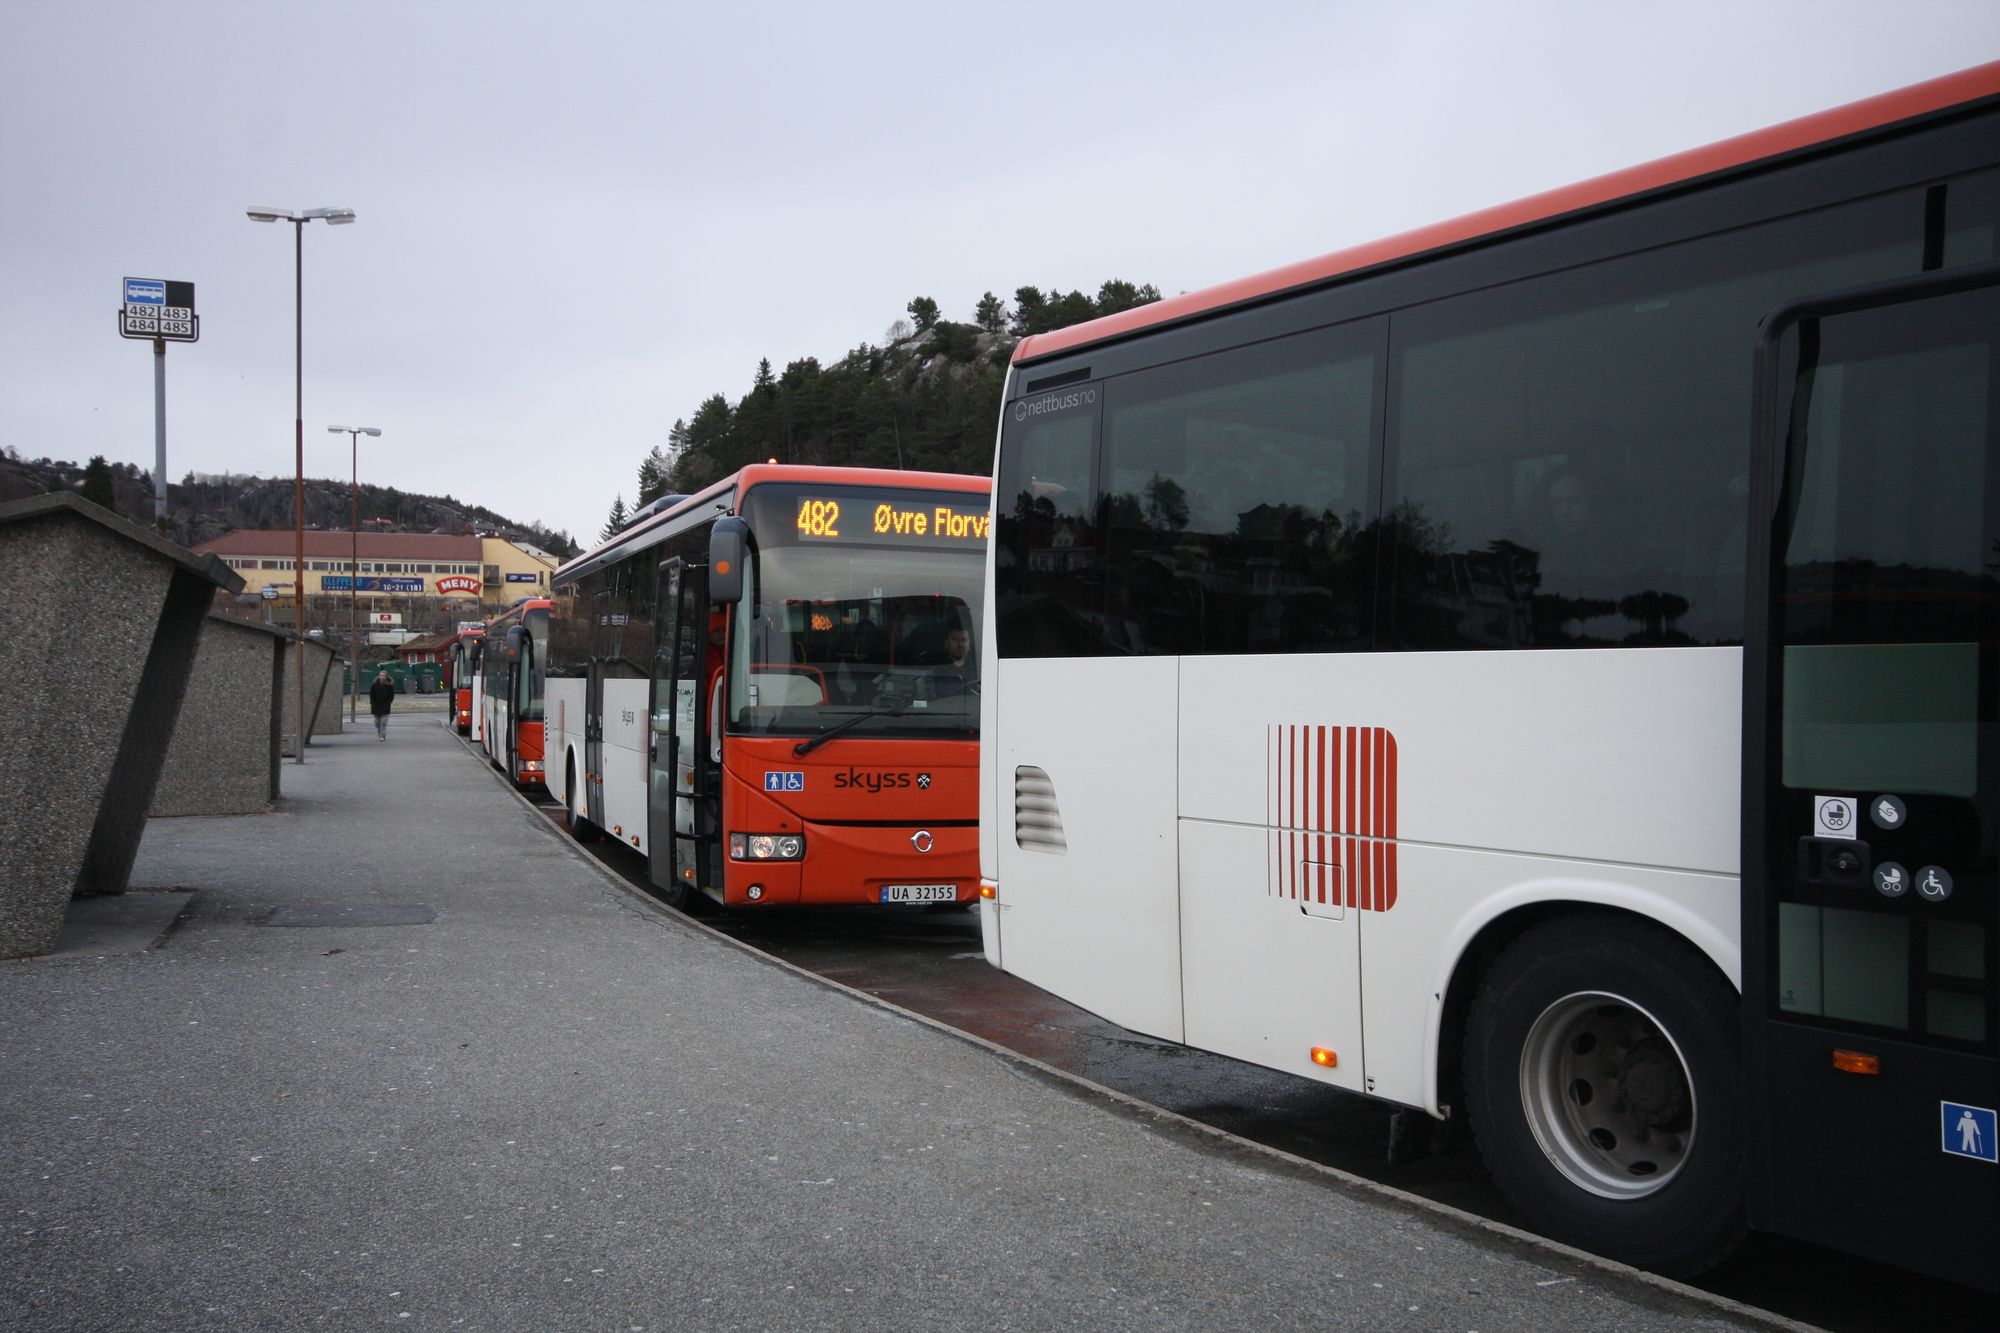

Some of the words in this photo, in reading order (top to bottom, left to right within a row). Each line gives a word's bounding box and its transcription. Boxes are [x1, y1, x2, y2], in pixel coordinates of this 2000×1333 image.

[129, 305, 155, 317] 482
[163, 308, 189, 319] 483
[129, 320, 155, 331] 484
[163, 322, 189, 333] 485
[797, 500, 839, 536] 482
[874, 504, 928, 535] Øvre
[441, 579, 478, 590] MENY
[834, 767, 911, 793] skyss
[892, 888, 909, 900] UA
[916, 887, 953, 900] 32155
